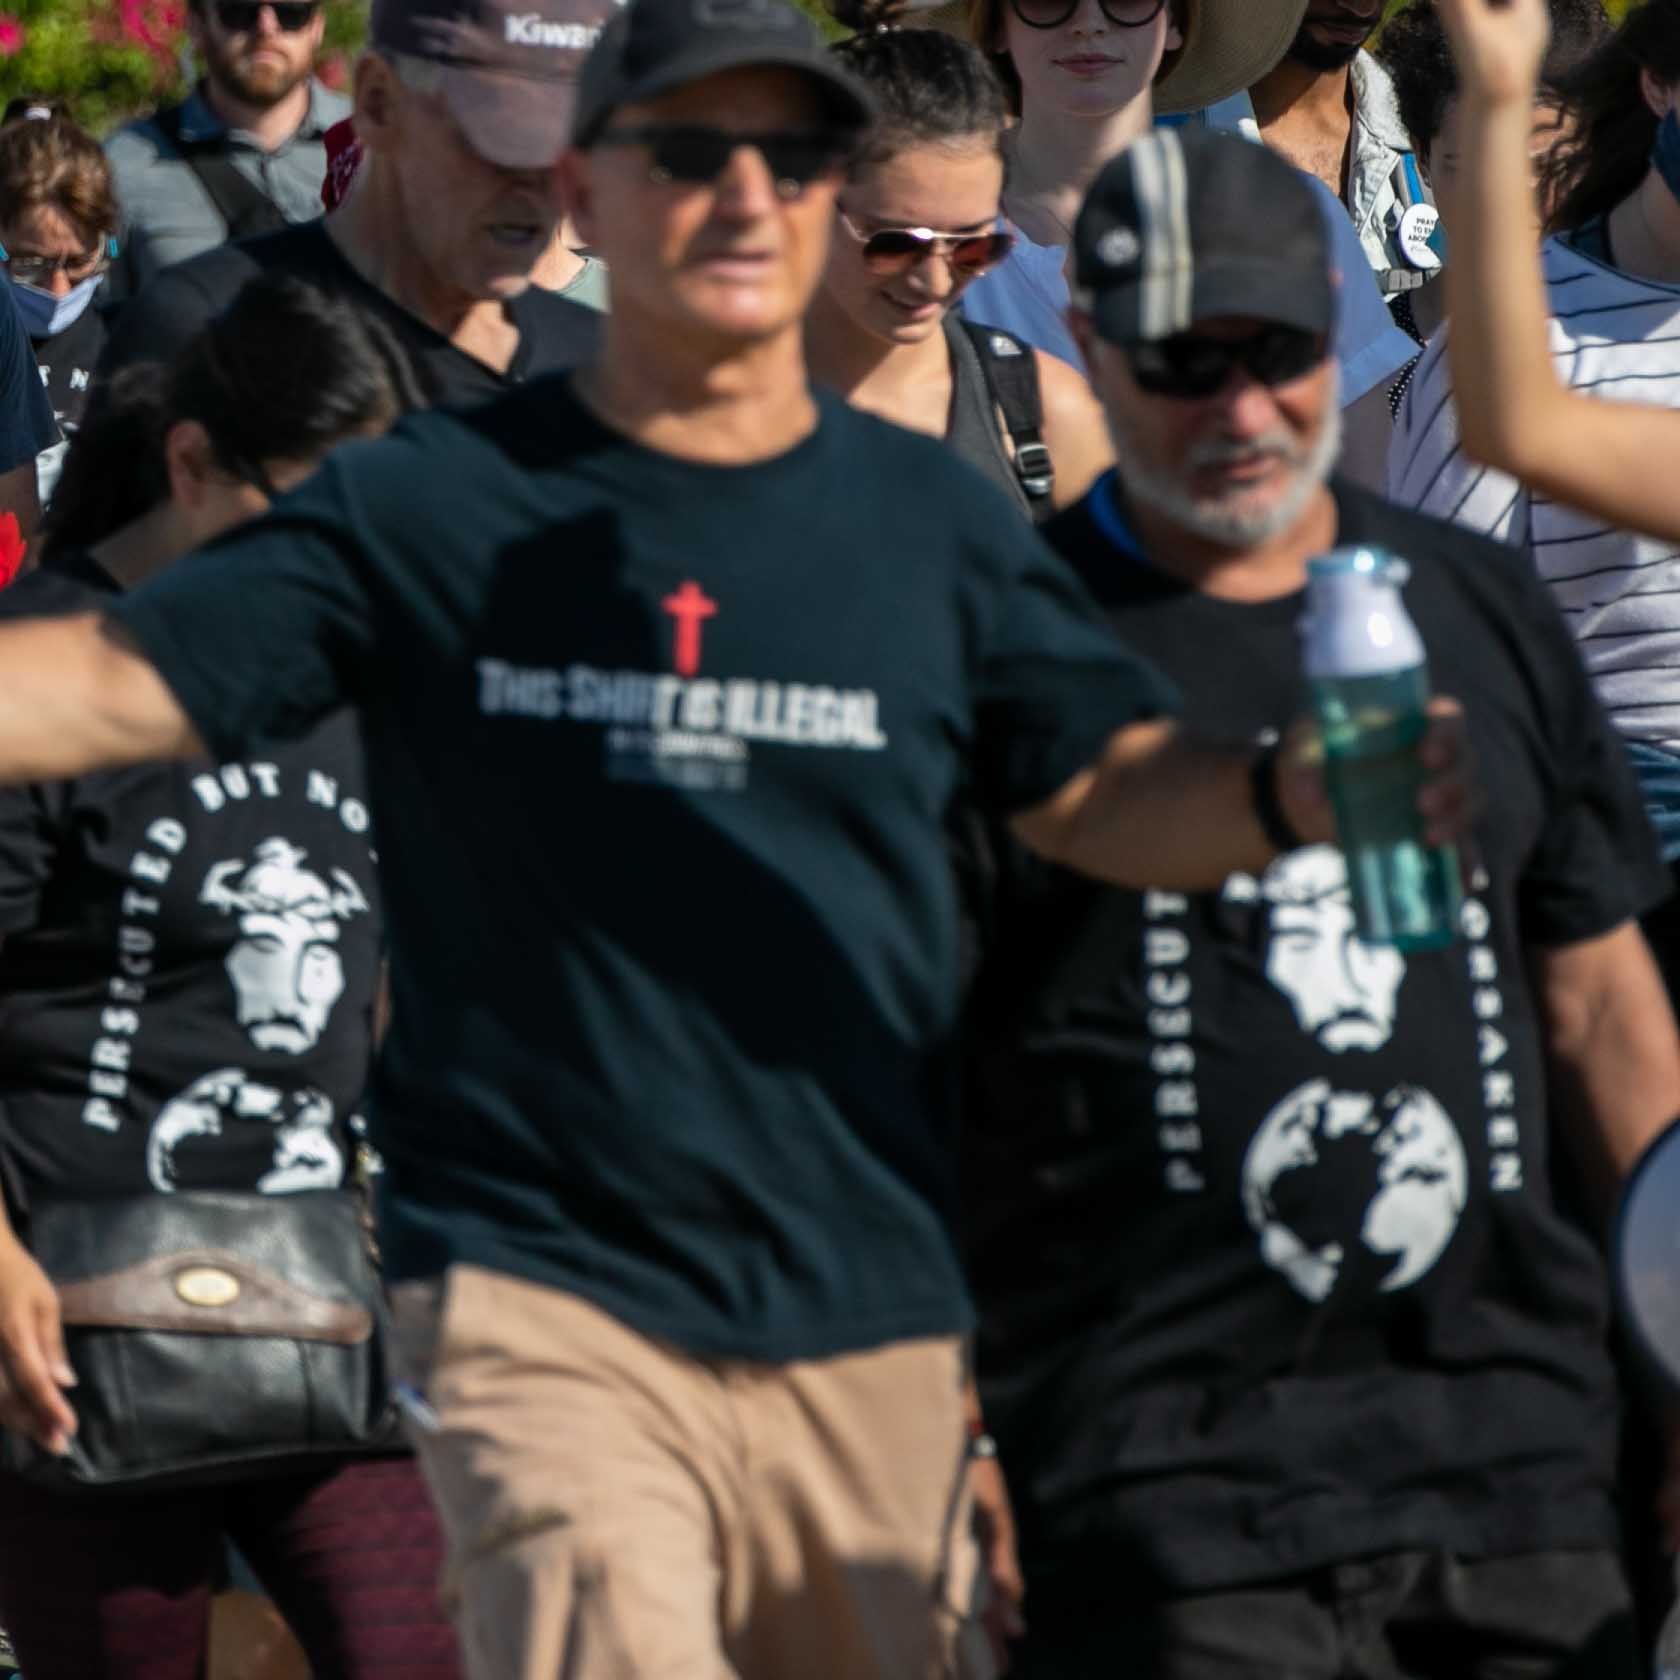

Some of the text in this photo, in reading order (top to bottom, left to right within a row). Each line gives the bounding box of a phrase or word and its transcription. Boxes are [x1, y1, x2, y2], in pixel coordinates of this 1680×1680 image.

[503, 12, 603, 50] Kiwan
[81, 762, 372, 1132] PERSECUTED BUT NO
[1144, 890, 1205, 1191] PERSECUT
